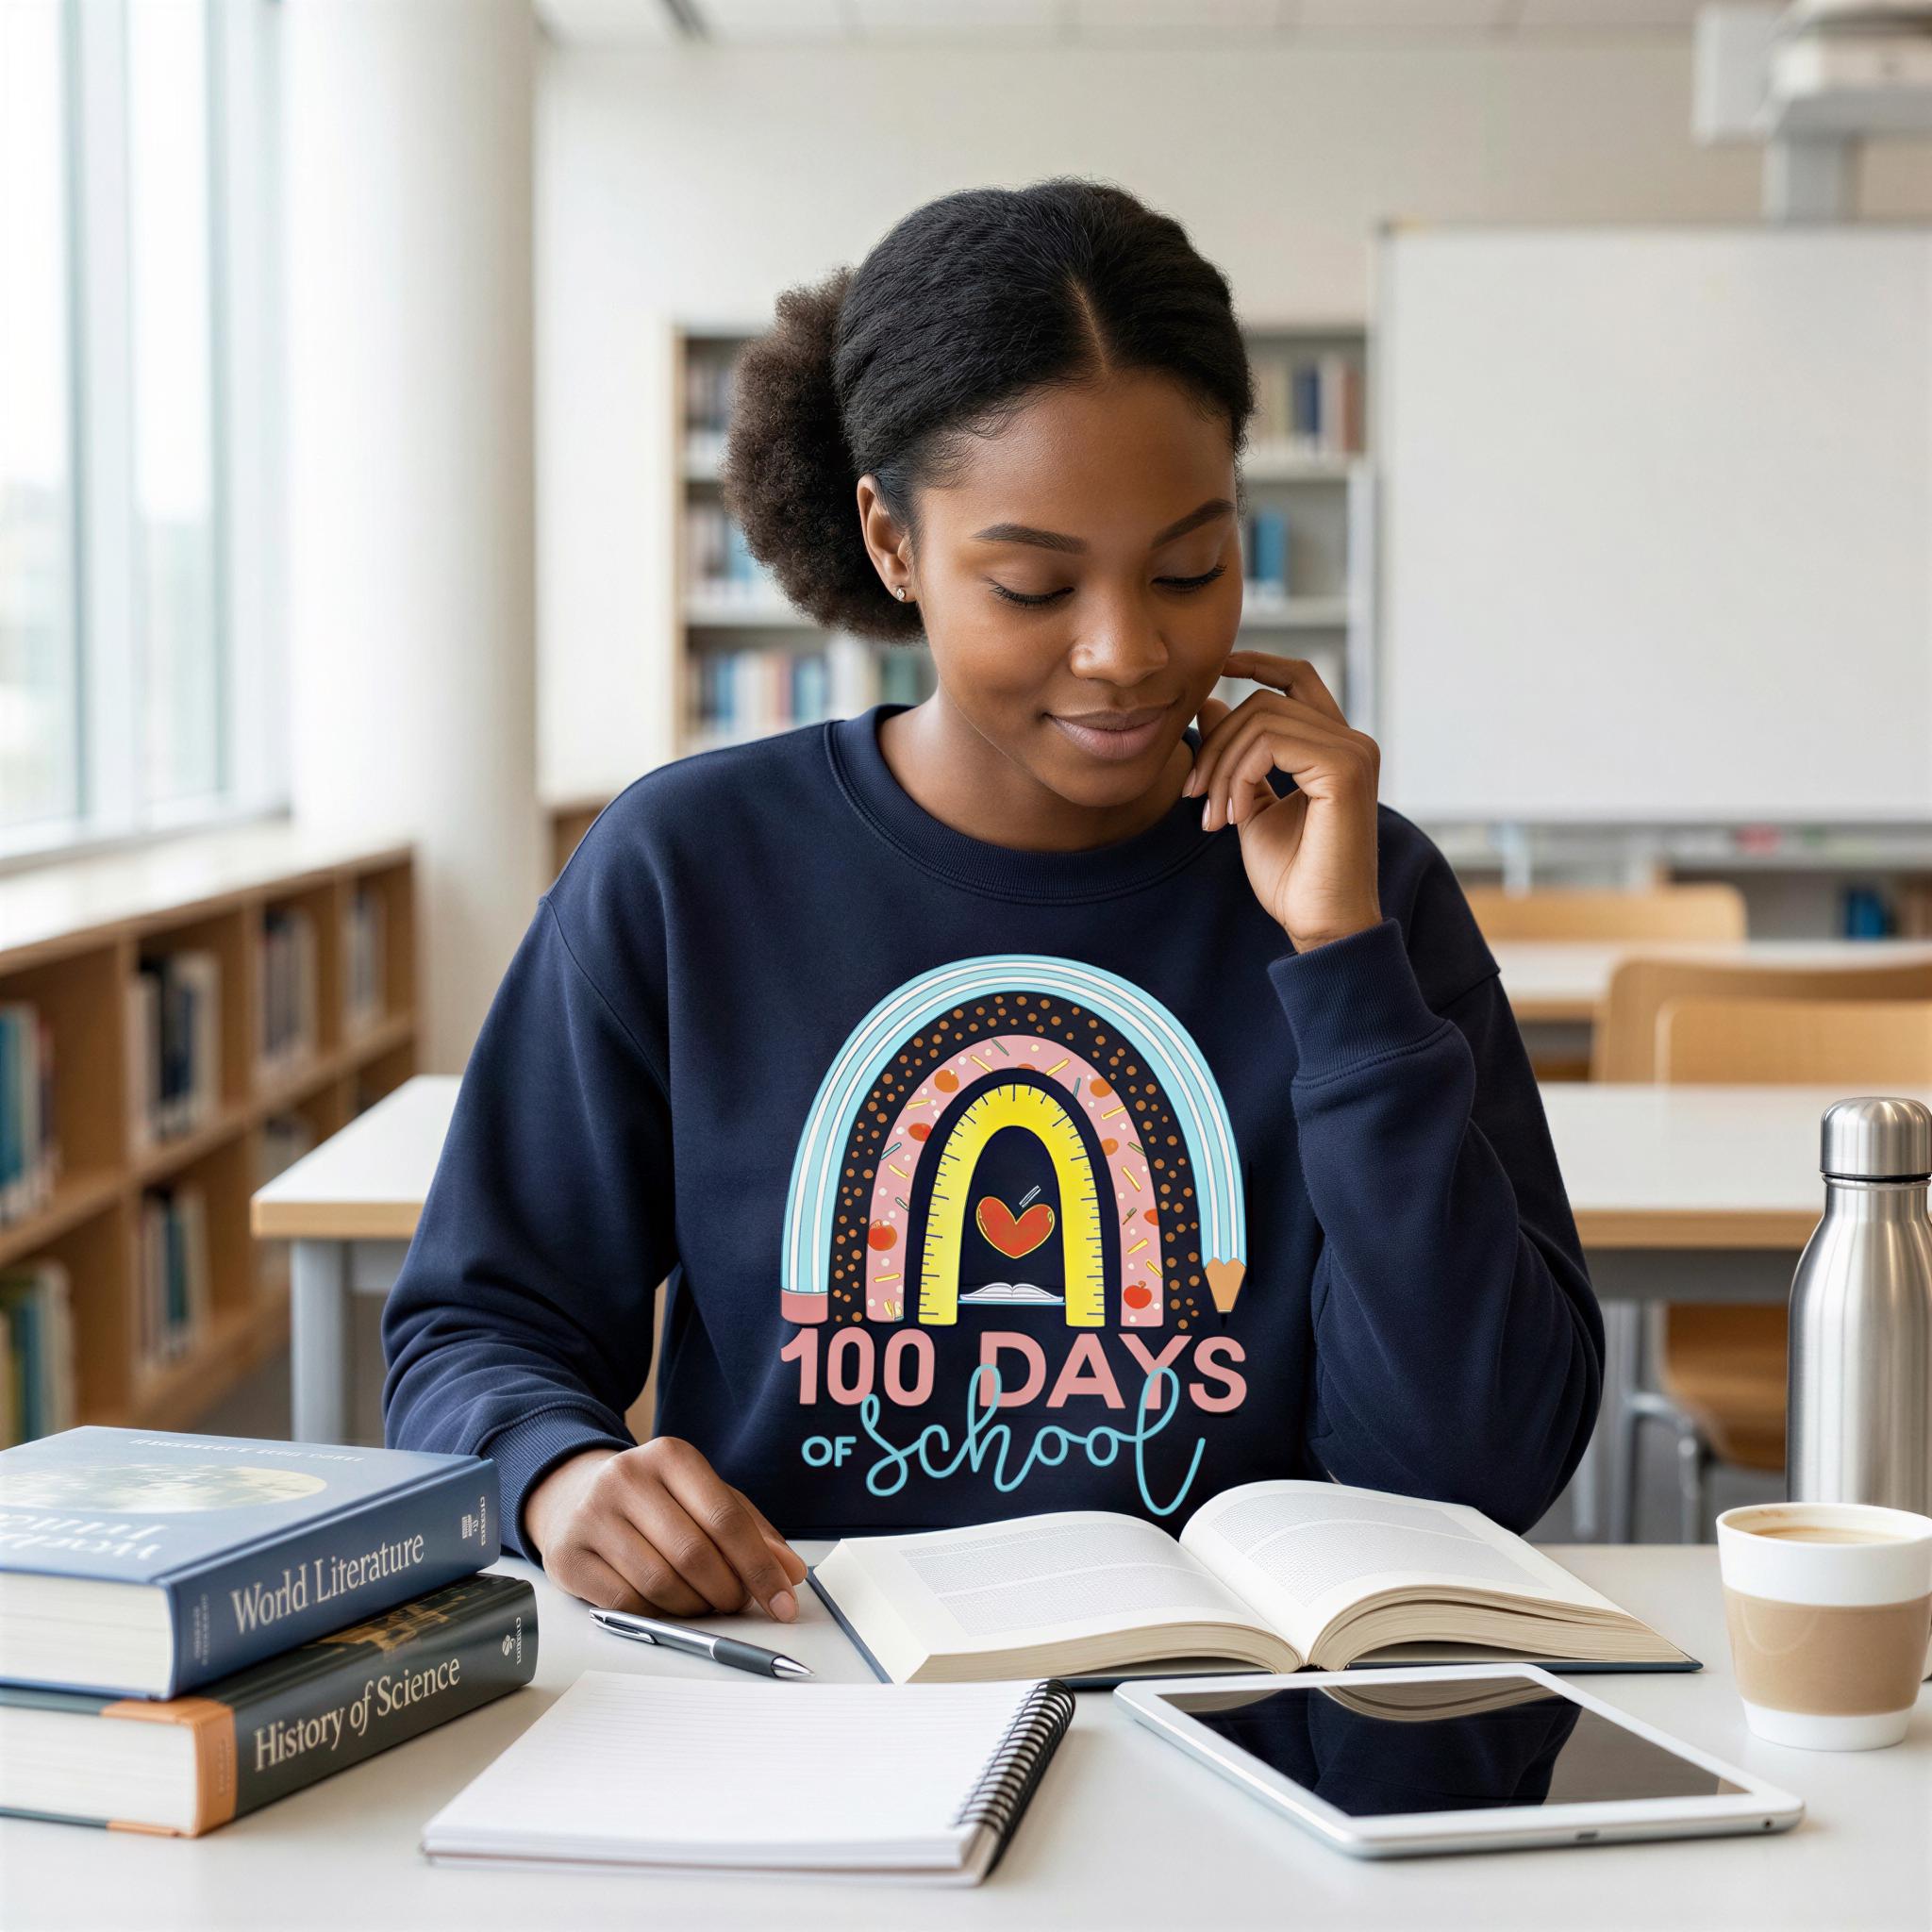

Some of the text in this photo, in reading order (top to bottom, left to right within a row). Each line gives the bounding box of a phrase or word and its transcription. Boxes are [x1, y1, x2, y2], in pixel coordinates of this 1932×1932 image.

[780, 1327, 1247, 1413] 100 DAYS
[801, 1436, 857, 1467] OF
[231, 1563, 308, 1636] World
[313, 1533, 425, 1609] Literature
[253, 1706, 344, 1773] History
[349, 1679, 375, 1737] of
[376, 1657, 461, 1718] Science
